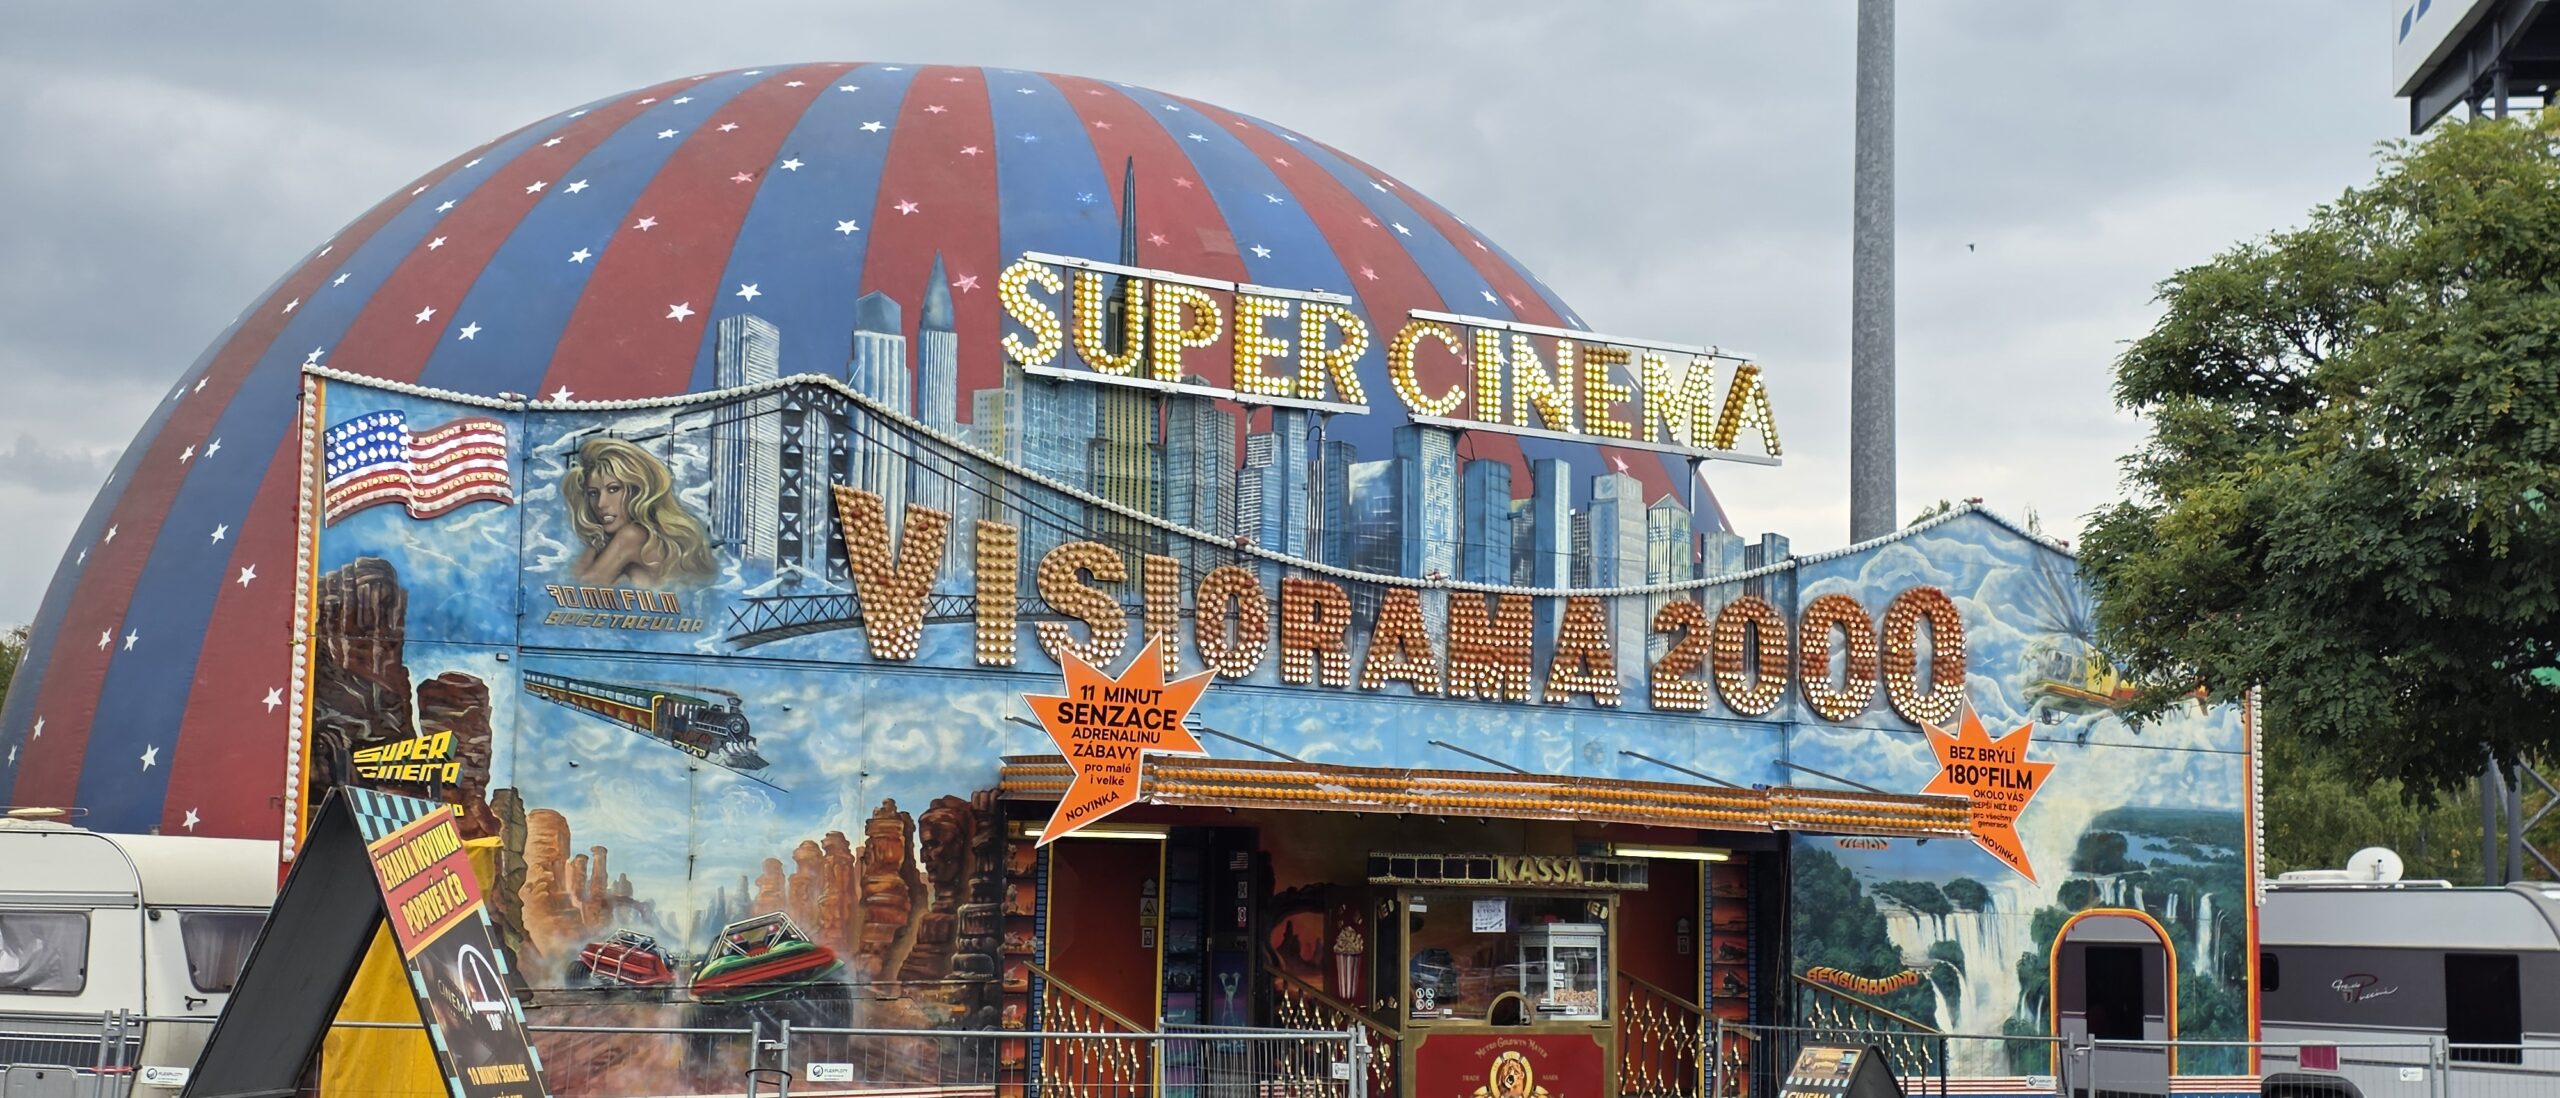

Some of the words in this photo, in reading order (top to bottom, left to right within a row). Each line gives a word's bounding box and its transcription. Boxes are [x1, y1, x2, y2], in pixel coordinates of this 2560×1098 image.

[998, 260, 1370, 406] SUPER
[1387, 319, 1783, 457] CINEMA
[619, 589, 681, 614] FILM
[832, 484, 1622, 707] VISIORAMA
[1652, 585, 1967, 726] 2000
[544, 610, 705, 633] SPECTACULAR
[1080, 685, 1096, 700] 11
[1104, 687, 1163, 706] MINUT
[1057, 702, 1178, 731] SENZACE
[353, 730, 455, 763] SUPER
[1071, 727, 1161, 744] ADRENALINU
[1073, 741, 1139, 760] ZÁBAVY
[1950, 745, 1975, 760] BEZ
[1979, 746, 2016, 764] BRÝLÍ
[356, 762, 462, 785] CINEMA
[1084, 763, 1103, 774] pro
[1105, 763, 1132, 774] malé
[1090, 774, 1094, 784] i
[1097, 775, 1125, 786] velké
[1065, 791, 1120, 822] NOVINKA
[1973, 789, 2005, 801] OKOLO
[2007, 789, 2024, 802] VÁS
[1993, 802, 2007, 811] NEŽ
[373, 835, 418, 893] ŽHAVÁ
[409, 819, 463, 870] NOVINKA
[1982, 834, 2019, 866] NOVINKA
[1498, 855, 1585, 884] KASSA
[440, 880, 455, 912] V
[443, 866, 469, 907] ČR
[401, 875, 446, 938] POPRVÉ
[1807, 967, 1919, 996] SENSURROUND
[437, 979, 473, 1025] CINEMA
[467, 1066, 480, 1085] 10
